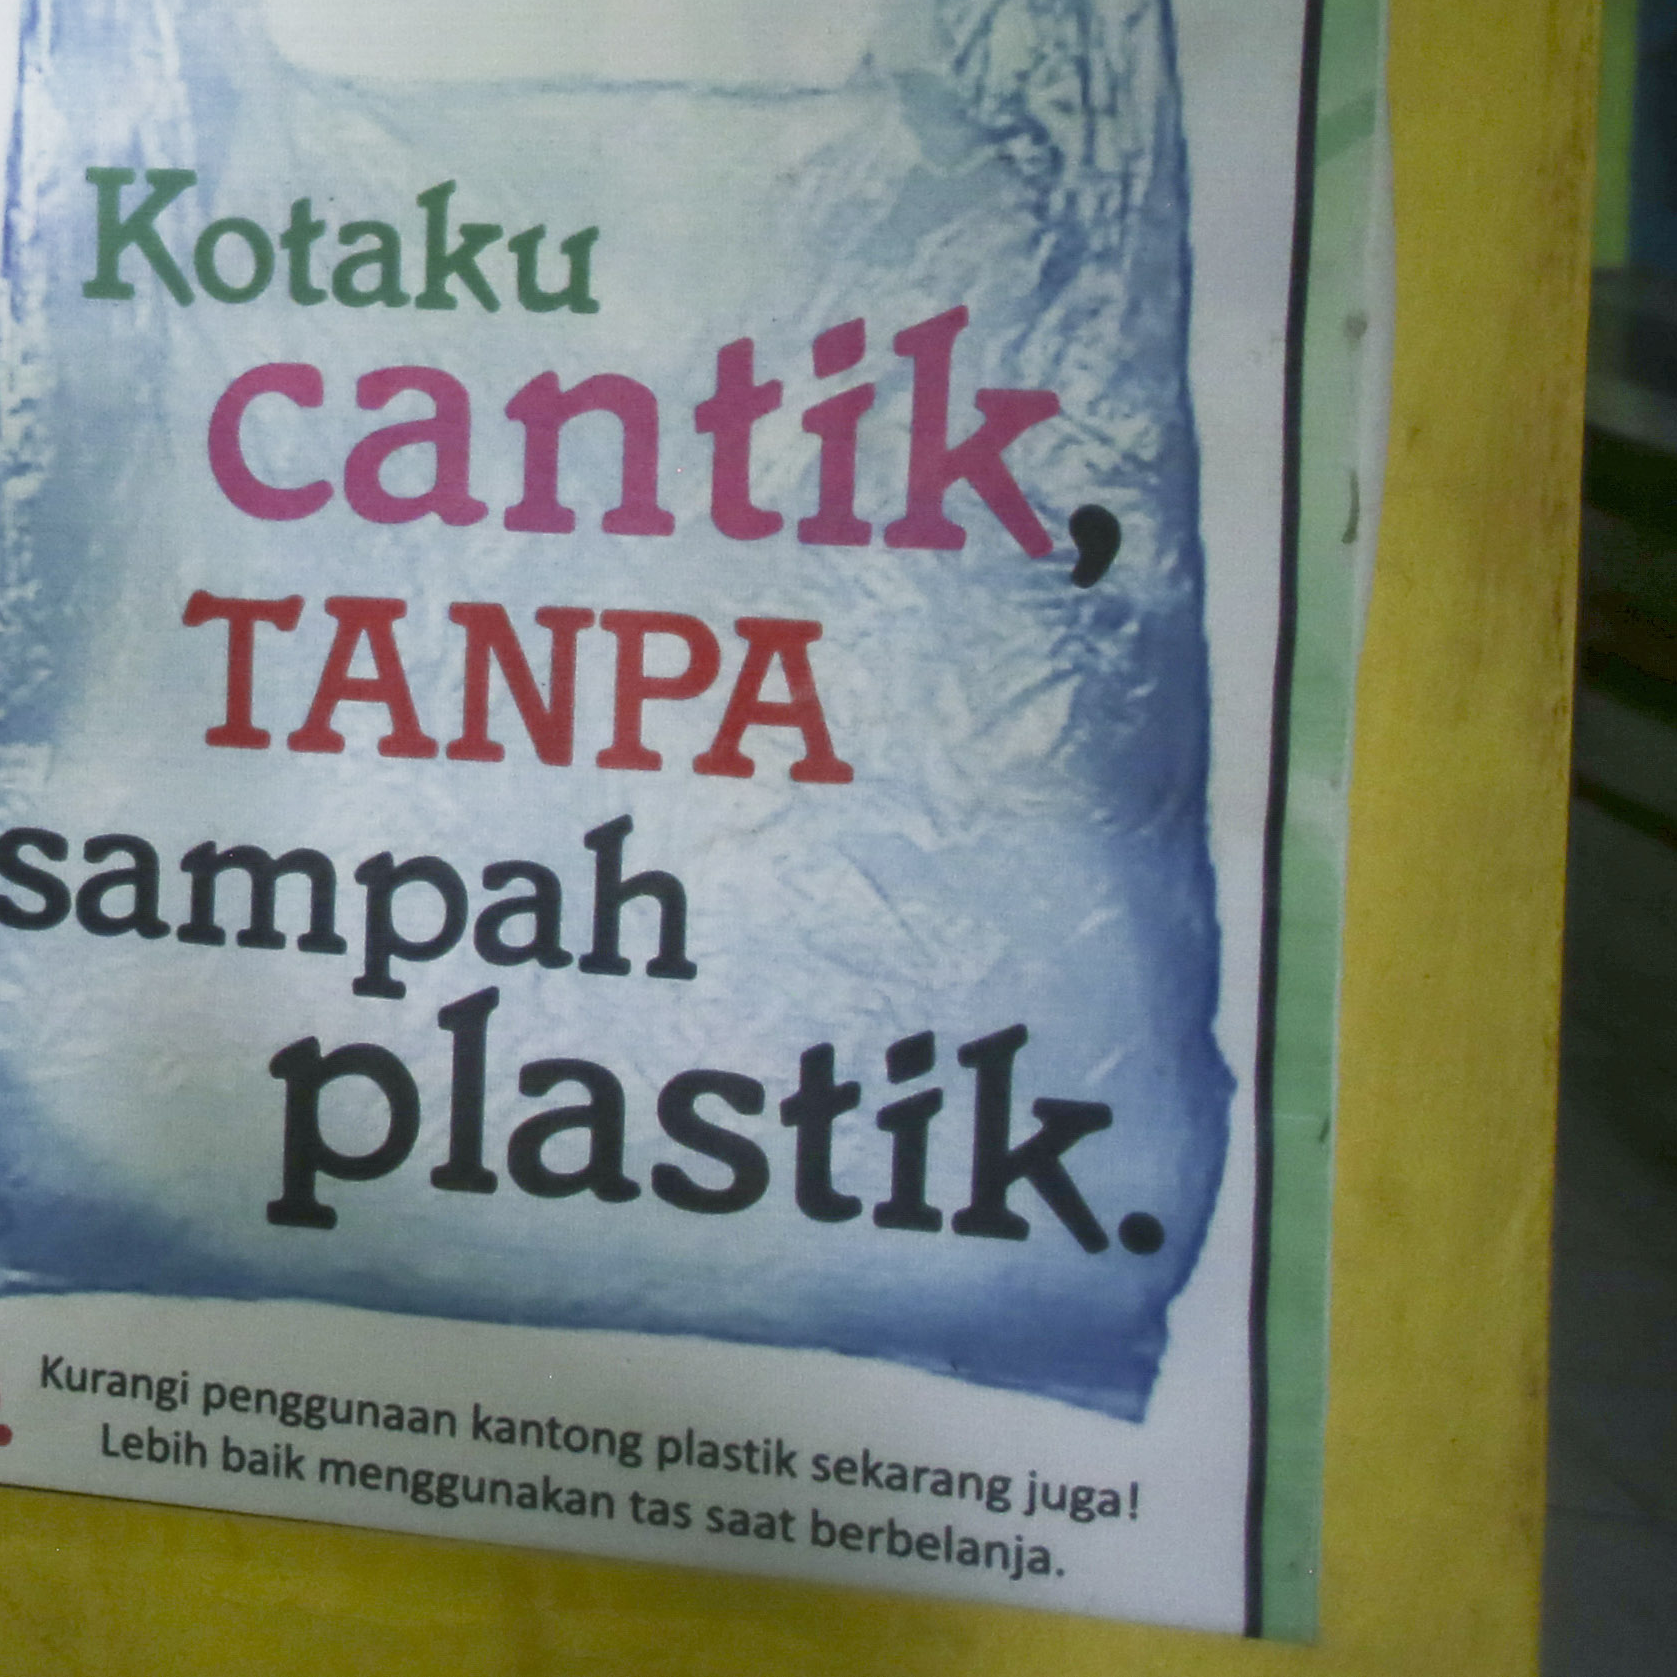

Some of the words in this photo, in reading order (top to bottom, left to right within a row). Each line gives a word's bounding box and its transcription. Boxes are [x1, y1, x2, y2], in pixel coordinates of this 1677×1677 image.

[81, 165, 602, 316] Kotaku
[206, 303, 1124, 590] cantik,
[180, 588, 856, 786] TANPA
[264, 985, 1167, 1258] plastik.
[40, 1354, 190, 1411] Kurangi
[202, 1377, 458, 1438] penggunaan
[471, 1402, 643, 1469] kantong
[656, 1428, 799, 1480] plastik
[811, 1447, 1013, 1514] sekarang
[1023, 1470, 1142, 1524] juga!
[101, 1423, 208, 1470] Lebih
[221, 1435, 306, 1482] baik
[317, 1453, 617, 1520] menggunakan
[629, 1487, 693, 1531] tas
[705, 1501, 797, 1544] saat
[809, 1508, 1067, 1582] berbelanja.
